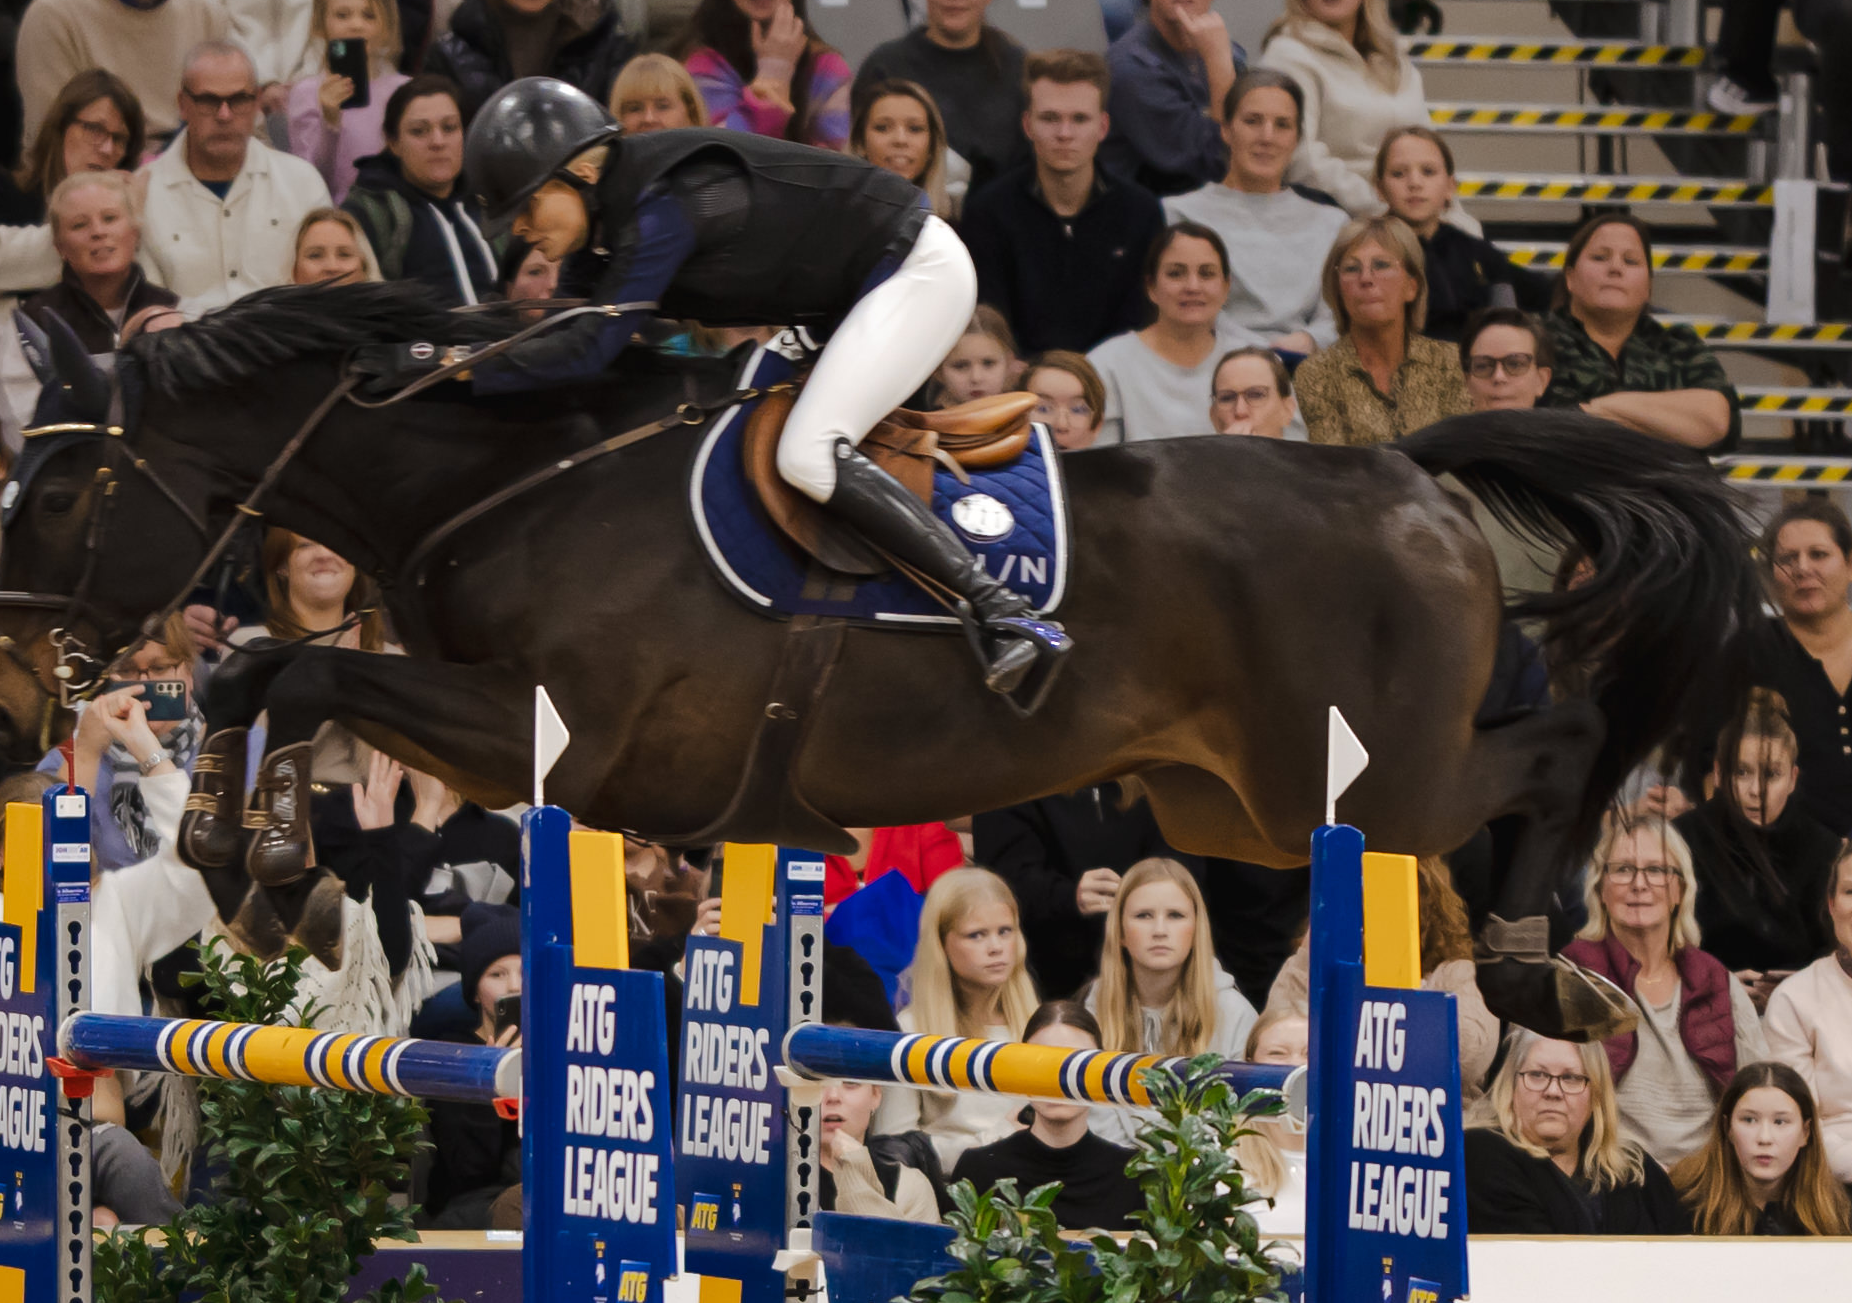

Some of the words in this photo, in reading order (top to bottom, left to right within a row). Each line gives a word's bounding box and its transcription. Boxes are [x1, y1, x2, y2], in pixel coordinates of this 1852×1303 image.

[687, 949, 734, 1013] ATG
[566, 983, 616, 1056] ATG
[1354, 1000, 1407, 1072] ATG
[685, 1021, 770, 1091] RIDERS
[565, 1064, 655, 1142] RIDERS
[682, 1093, 772, 1165] LEAGUE
[1352, 1080, 1447, 1158] RIDERS
[563, 1146, 659, 1224] LEAGUE
[691, 1202, 718, 1231] ATG
[1348, 1161, 1450, 1239] LEAGUE
[618, 1271, 648, 1303] ATG
